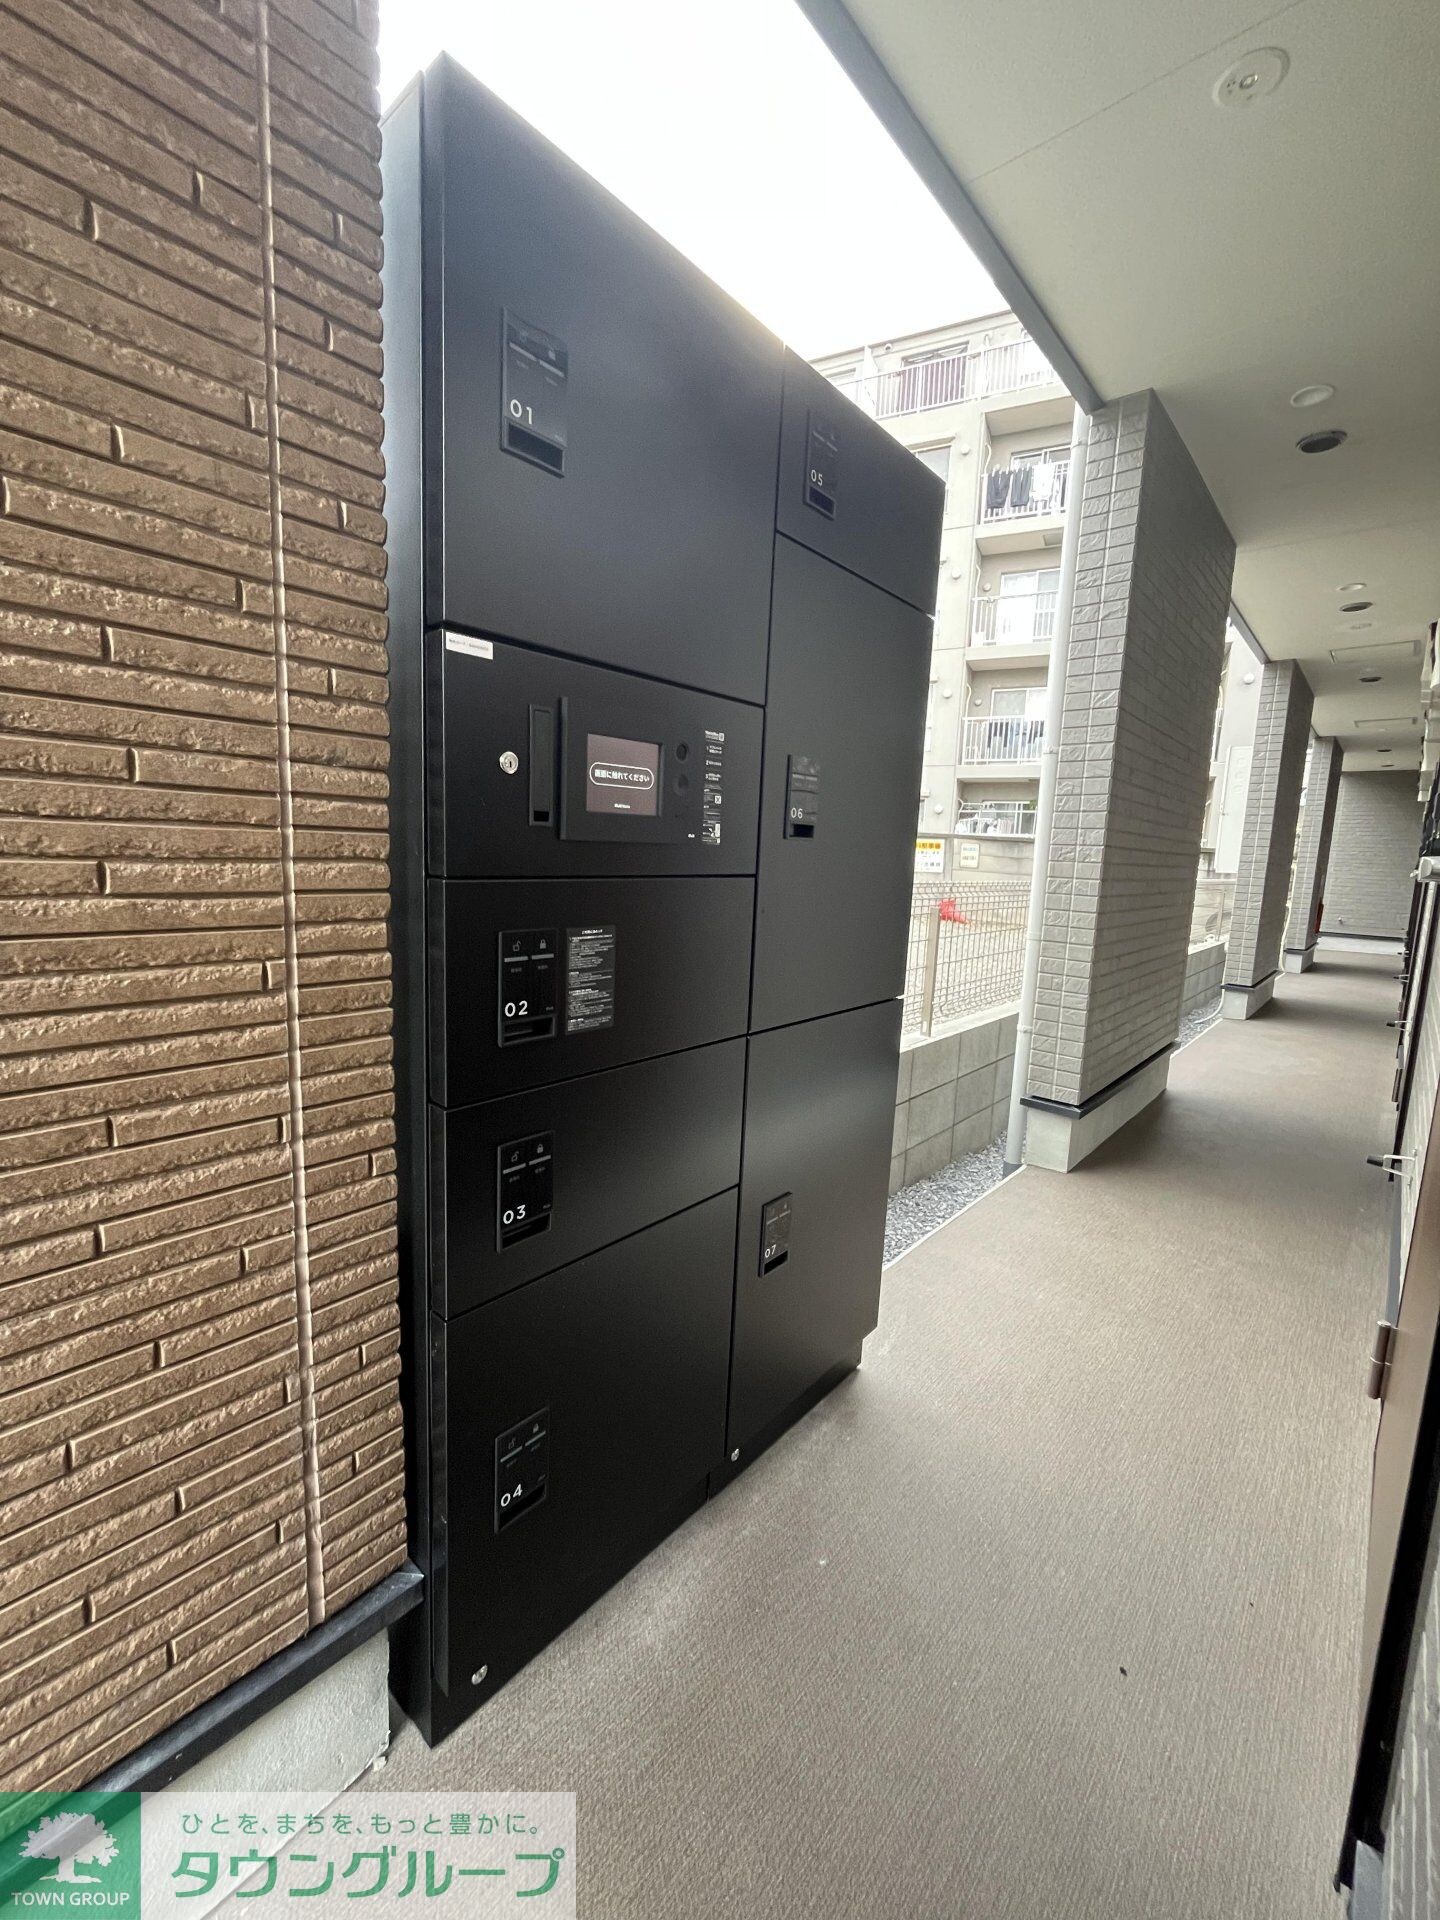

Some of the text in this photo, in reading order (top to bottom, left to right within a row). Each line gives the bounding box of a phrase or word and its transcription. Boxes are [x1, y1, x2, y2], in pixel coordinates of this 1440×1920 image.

[509, 398, 533, 425] 01
[810, 469, 823, 487] 05
[790, 807, 803, 819] 06
[504, 1000, 528, 1018] 02
[502, 1204, 526, 1225] 03
[764, 1244, 777, 1258] 07
[500, 1483, 523, 1507] 04
